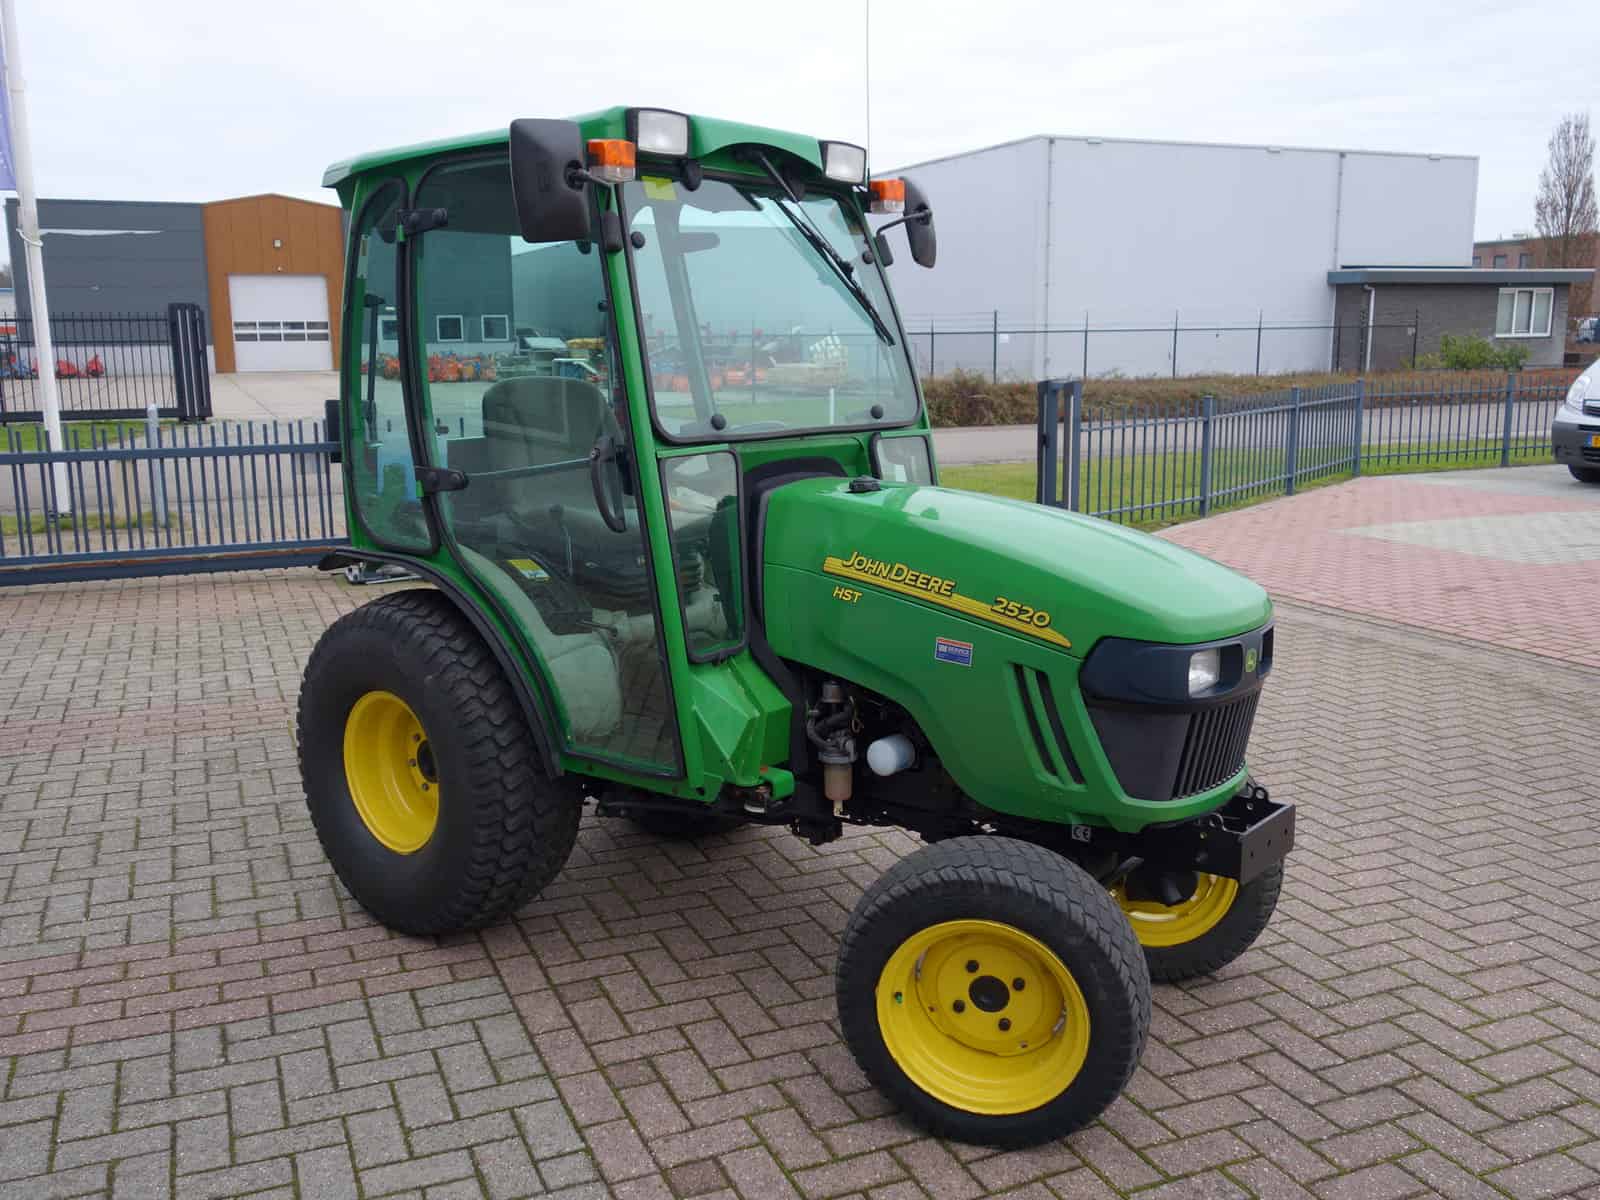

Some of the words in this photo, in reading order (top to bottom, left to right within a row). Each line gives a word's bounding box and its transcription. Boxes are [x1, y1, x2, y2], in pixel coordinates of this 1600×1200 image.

[843, 552, 890, 578] JOHN
[890, 563, 955, 595] DEERE
[833, 587, 862, 603] HST
[991, 597, 1050, 626] 2520
